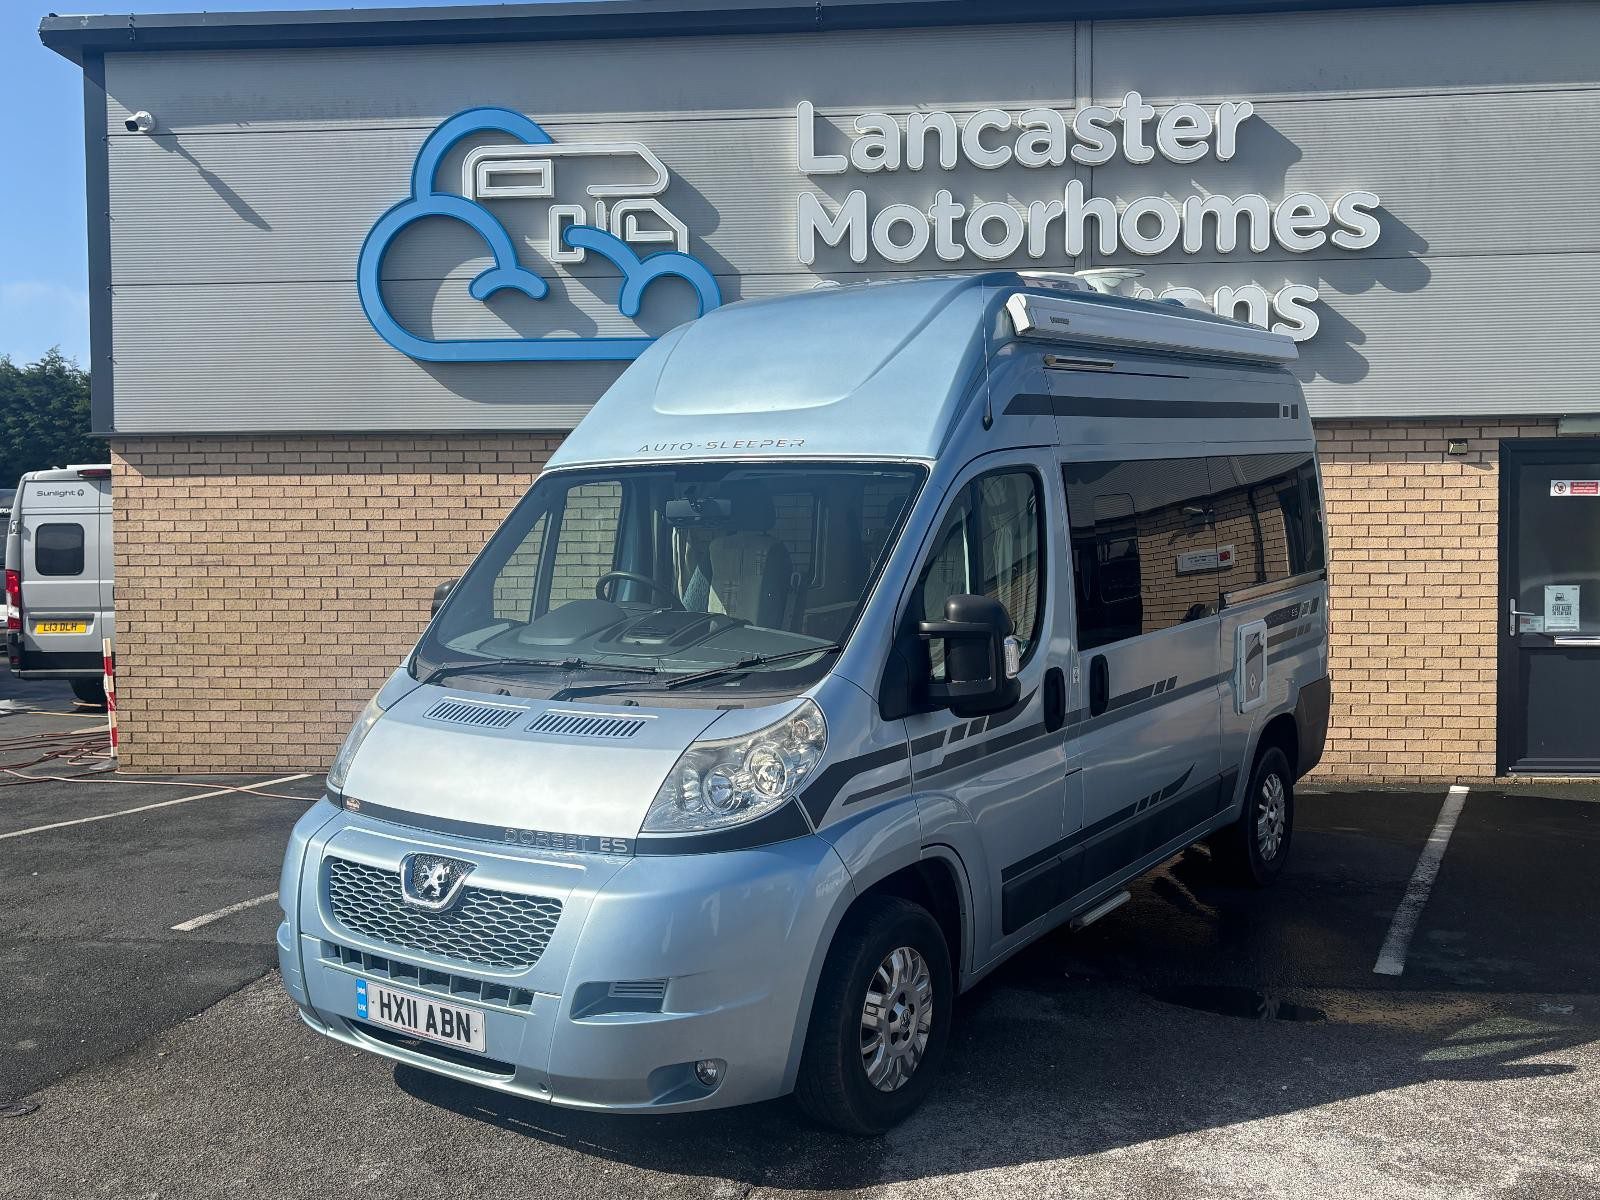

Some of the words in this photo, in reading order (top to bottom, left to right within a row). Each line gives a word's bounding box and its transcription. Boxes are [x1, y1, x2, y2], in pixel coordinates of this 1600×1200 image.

[797, 91, 1254, 175] Lancaster
[797, 179, 1381, 265] Motorhomes
[638, 439, 806, 453] AUTO-SLEEPER
[36, 490, 76, 498] Sunlight
[43, 622, 58, 632] L13
[59, 622, 77, 632] DLH
[504, 828, 590, 851] DORSET
[600, 837, 628, 853] ES
[379, 990, 418, 1029] HX11
[425, 1004, 471, 1043] ABN
